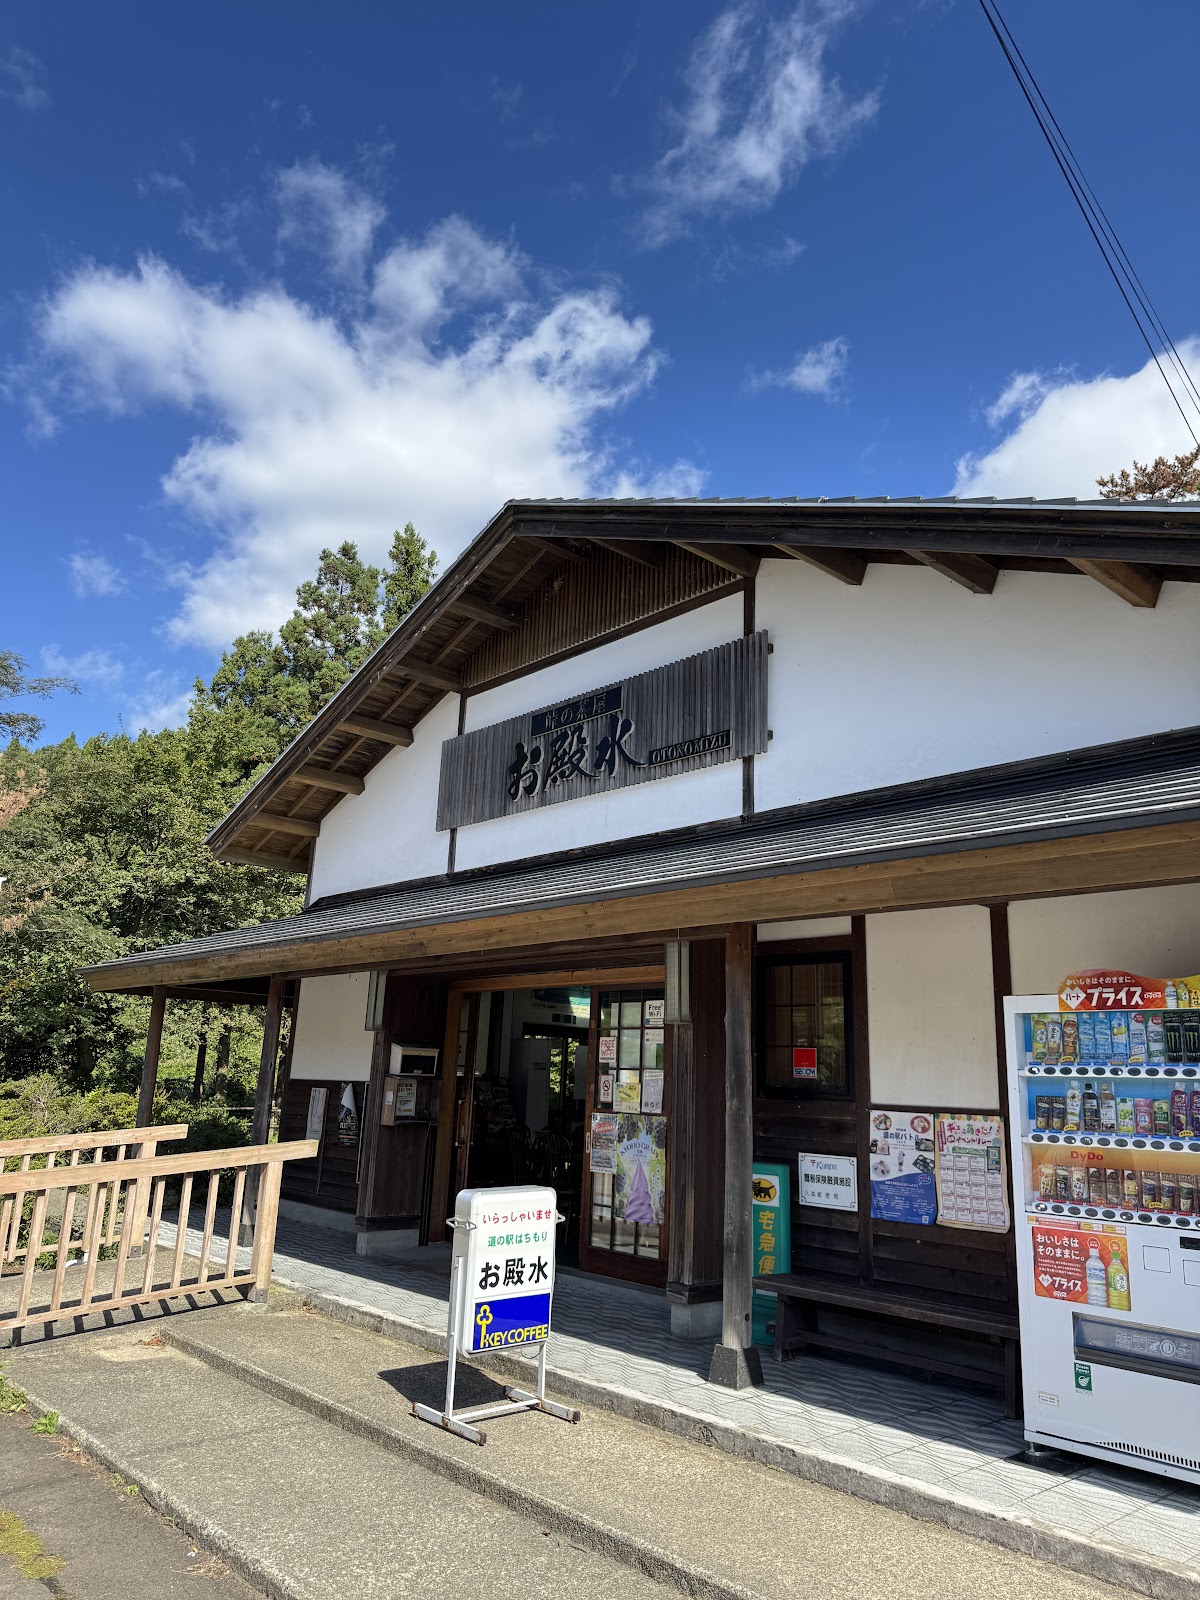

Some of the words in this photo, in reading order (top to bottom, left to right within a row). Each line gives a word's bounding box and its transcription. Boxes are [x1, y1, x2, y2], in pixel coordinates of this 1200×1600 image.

[545, 692, 607, 728] 峠の茶屋
[652, 731, 728, 764] OTONOMIZU
[507, 712, 648, 802] お殿水
[1066, 976, 1136, 986] おいしさはそのままに。
[1065, 992, 1081, 1001] ハート
[1086, 986, 1144, 1007] プライス
[649, 1003, 661, 1011] Free
[601, 1039, 615, 1048] FREE
[1070, 1150, 1104, 1161] DyDo
[816, 1160, 838, 1170] Kampo
[482, 1209, 552, 1224] いらっしゃいませ
[487, 1231, 548, 1247] 道の駅はちもり
[758, 1210, 776, 1275] 宅急便
[1036, 1233, 1080, 1248] おいしさは
[1037, 1245, 1085, 1261] そのままに。
[479, 1255, 548, 1290] お殿水
[1052, 1276, 1082, 1292] プライス
[485, 1330, 507, 1347] KEY
[507, 1324, 548, 1342] COFFEE
